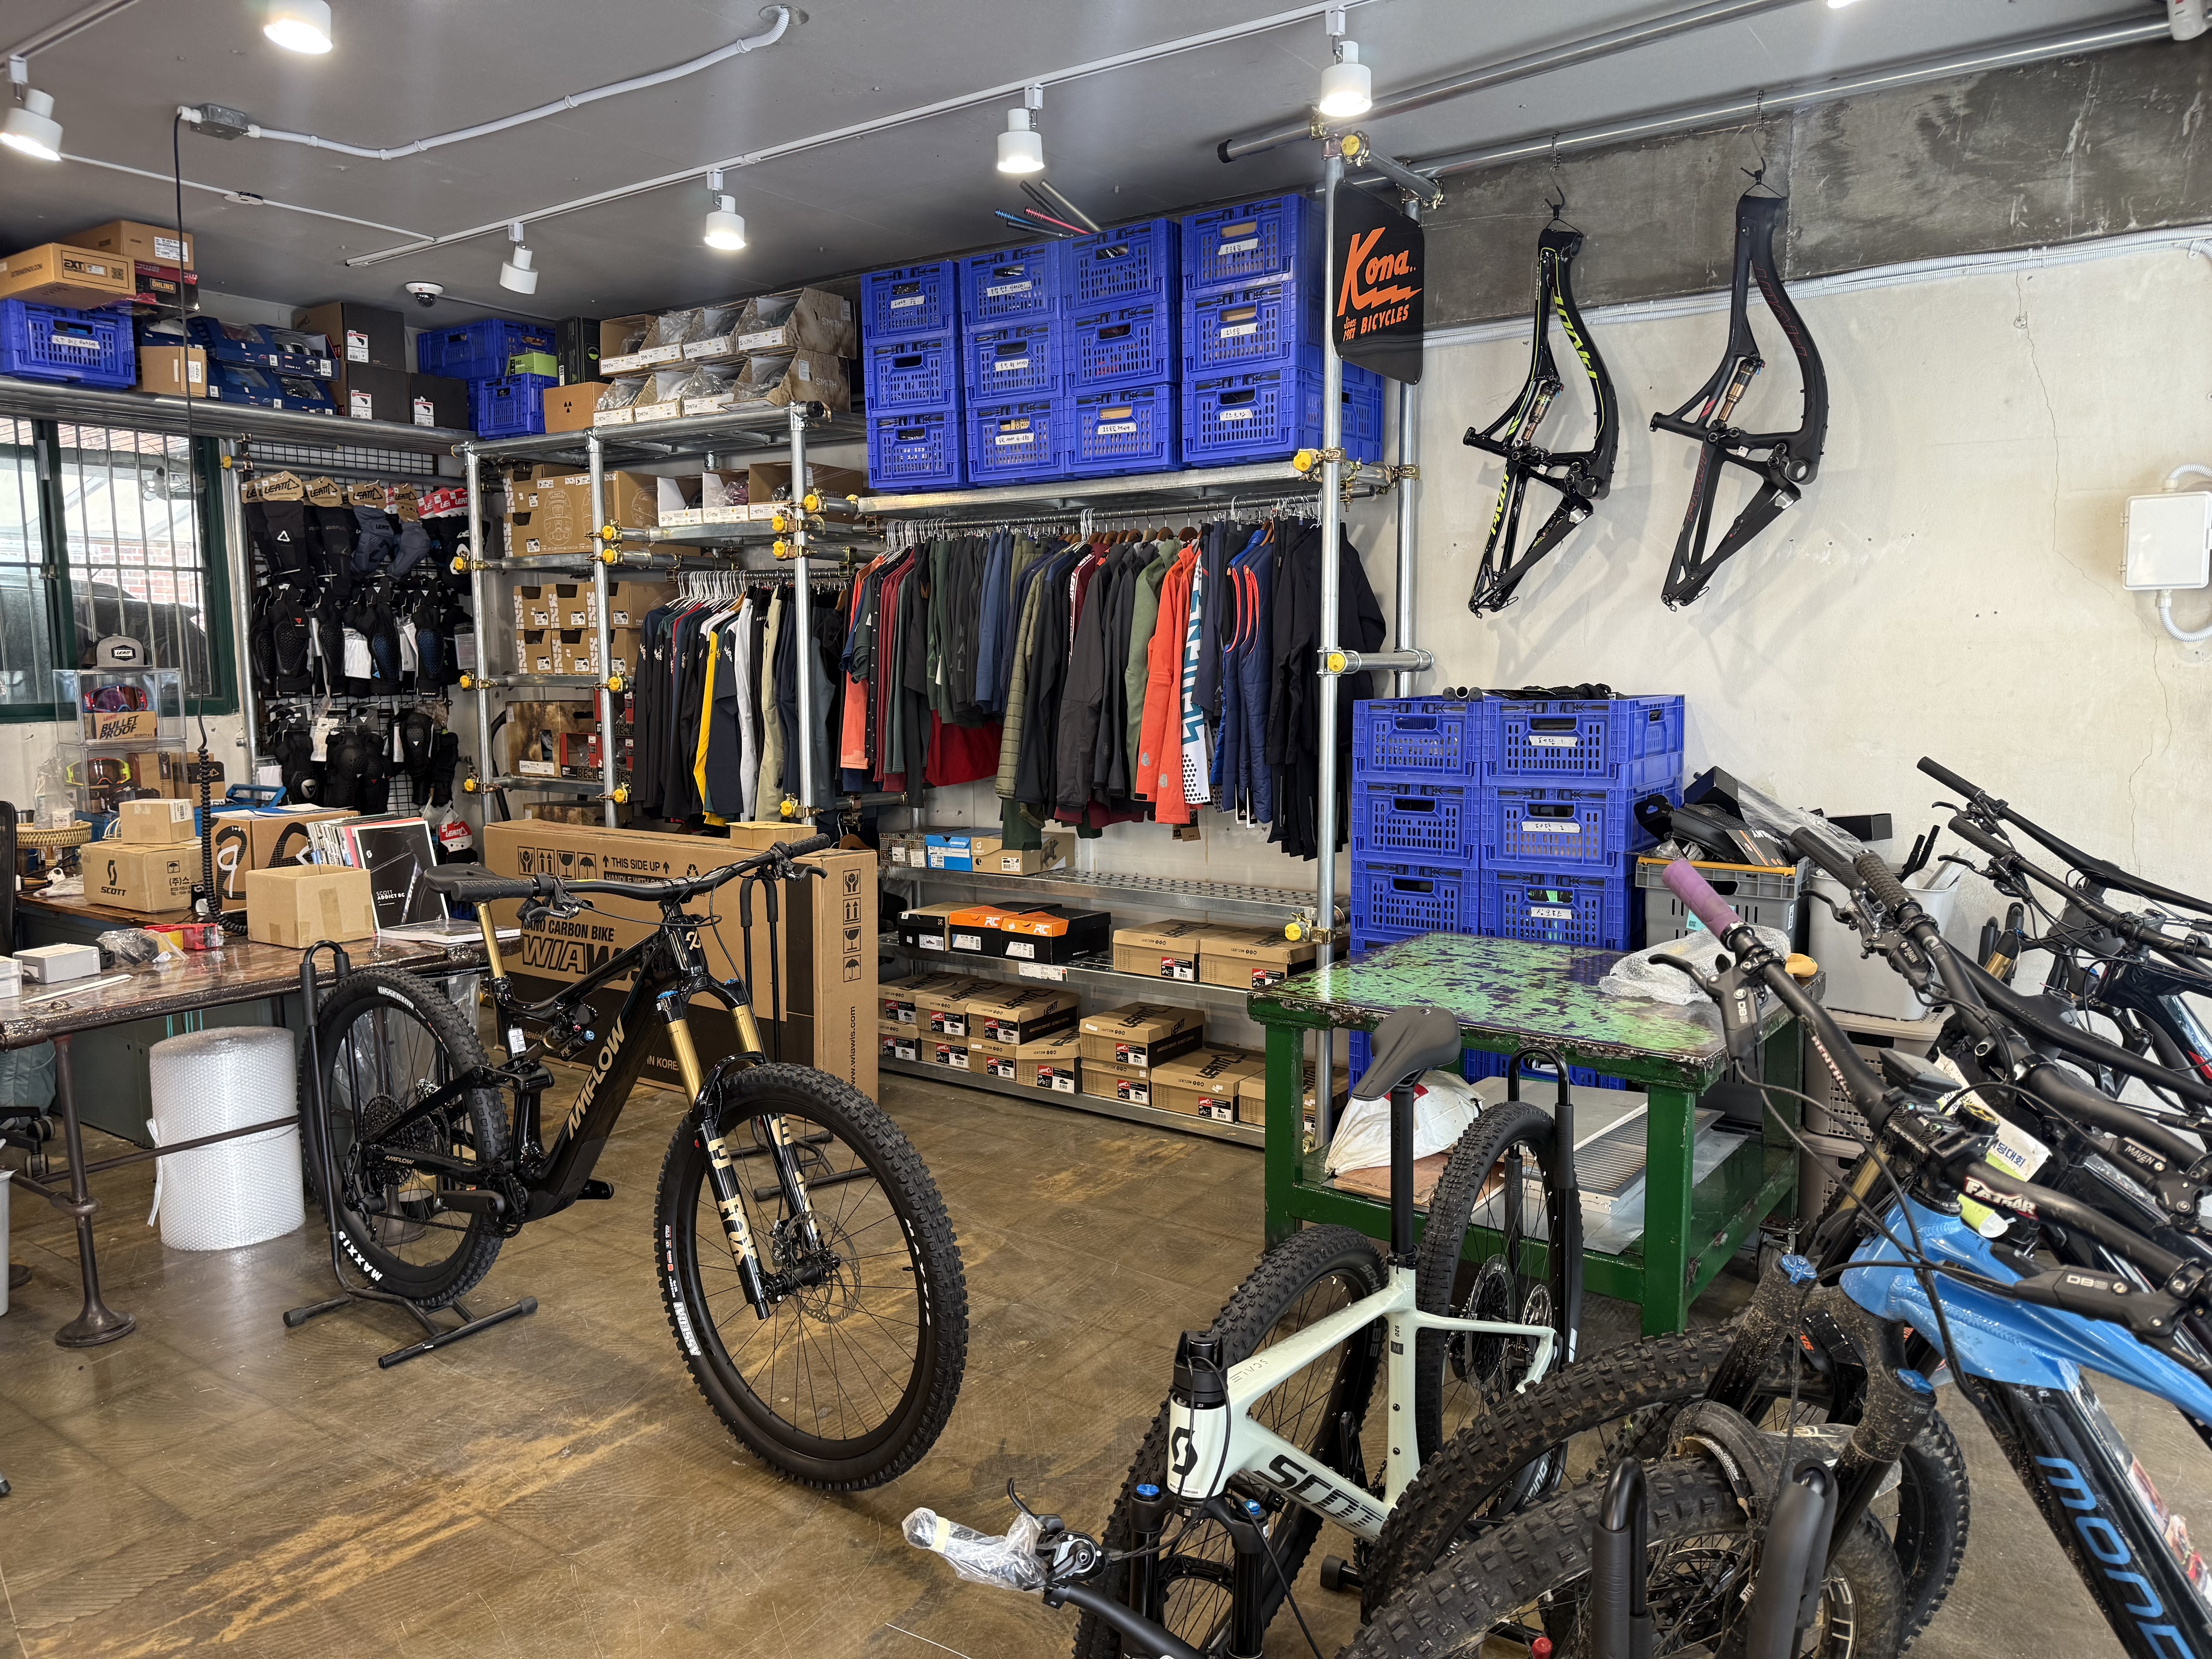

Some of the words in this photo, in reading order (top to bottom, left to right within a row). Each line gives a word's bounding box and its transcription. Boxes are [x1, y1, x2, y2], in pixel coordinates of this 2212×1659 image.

[64, 259, 84, 270] EXT
[1337, 227, 1417, 317] Kona
[821, 318, 843, 329] SMITH
[1360, 304, 1409, 334] BICYCLES
[1343, 327, 1356, 342] 1988
[816, 378, 837, 388] SMITH
[264, 480, 293, 495] LEATT
[310, 484, 333, 497] LEATT
[353, 489, 378, 500] LEATT
[395, 492, 413, 500] LEATT
[102, 715, 139, 730] BULLET
[100, 725, 137, 739] PROOF
[446, 828, 464, 837] LEATT
[611, 857, 628, 869] THIS
[631, 859, 648, 871] SIDE
[650, 862, 660, 872] UP
[169, 877, 194, 886] (주)스
[101, 886, 127, 896] SCOTT
[984, 916, 1001, 927] RC
[521, 919, 546, 934] NANO
[548, 920, 588, 939] CARBON
[591, 925, 615, 942] BIKE
[1033, 924, 1051, 935] RC
[1160, 921, 1199, 938] LEATT
[1905, 946, 1919, 963] MAVEN
[998, 988, 1042, 1010] LEATT
[1044, 1000, 1059, 1016] LEATT
[1118, 1005, 1169, 1028] LEATT
[1171, 1017, 1186, 1036] LEATT
[656, 1057, 679, 1071] KORE
[1196, 1053, 1240, 1079] LEATT
[567, 1016, 625, 1140] AMFLOW
[384, 1155, 414, 1165] AMFLOW
[1994, 1141, 2026, 1168] 딩대회
[2124, 1144, 2155, 1166] MAVEN
[1966, 1178, 2037, 1216] FATBAR
[718, 1194, 759, 1265] FOX
[338, 1231, 383, 1281] MAXXIS
[673, 1302, 701, 1356] ASSEGAI
[1258, 1454, 1389, 1538] SCOT
